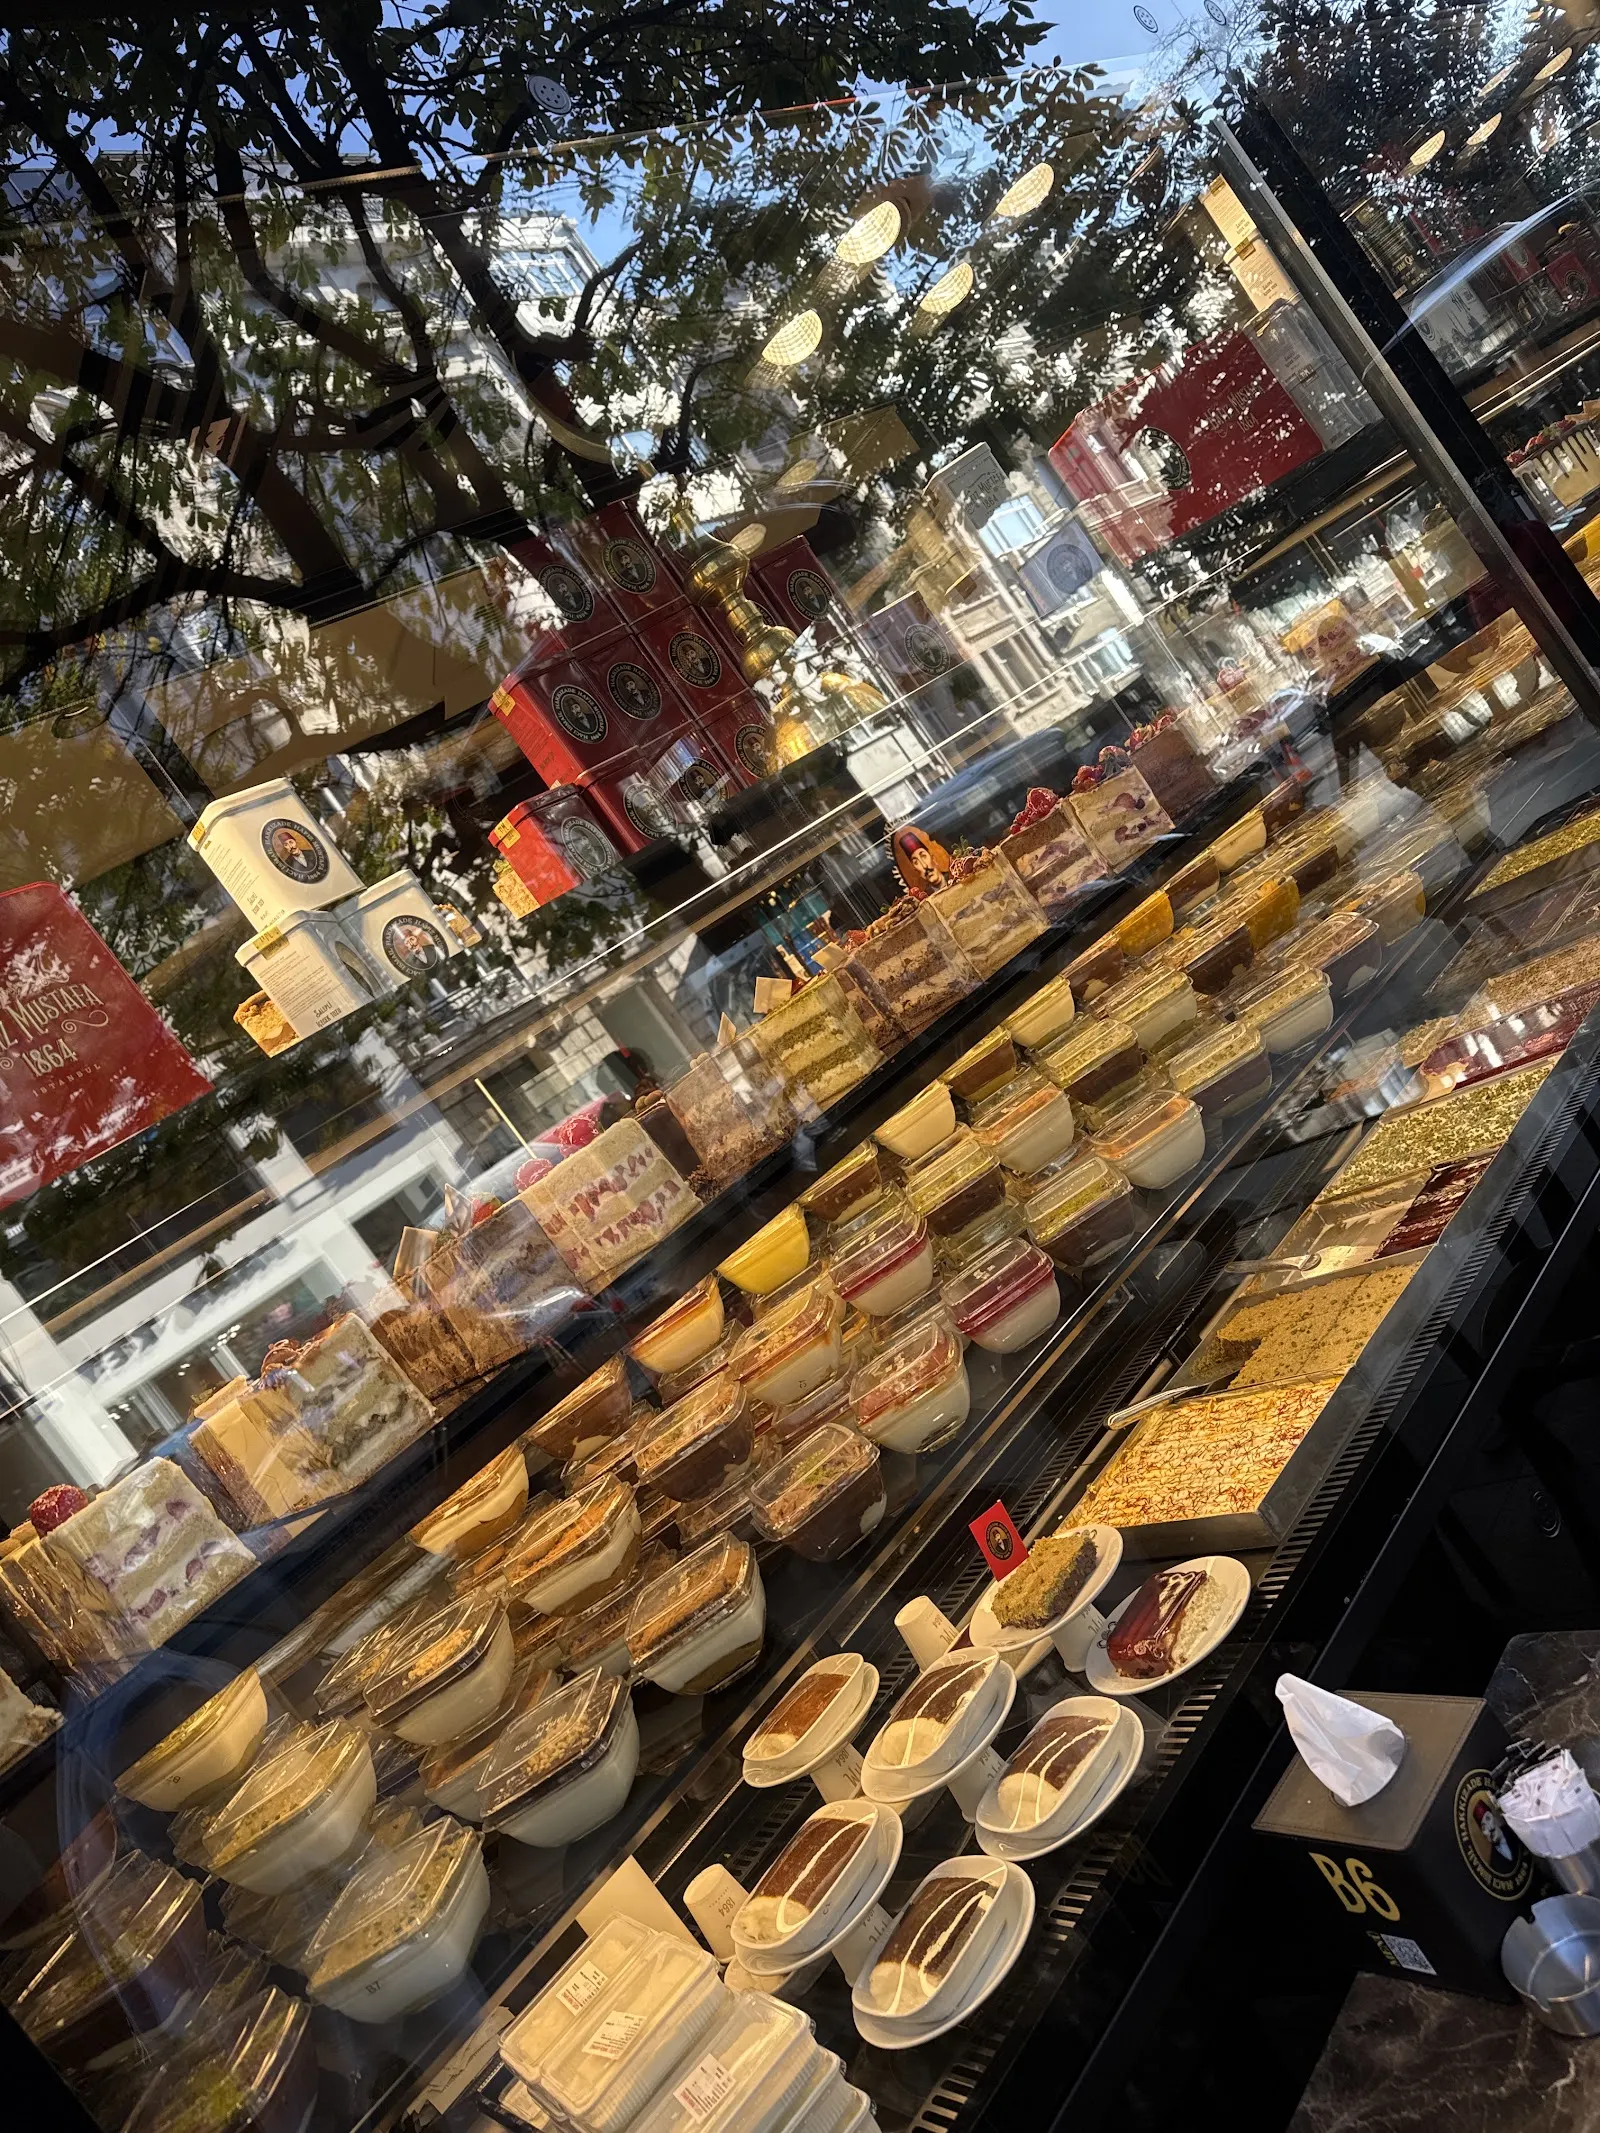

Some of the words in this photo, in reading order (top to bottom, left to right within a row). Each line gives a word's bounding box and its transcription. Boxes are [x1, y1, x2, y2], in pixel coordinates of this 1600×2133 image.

[7, 983, 105, 1042] MUSTAFA
[21, 1038, 78, 1078] 1864
[32, 1063, 102, 1098] ISTANBUL
[1307, 1852, 1401, 1922] B6
[717, 1895, 737, 1917] 1864
[365, 1980, 381, 1997] B7
